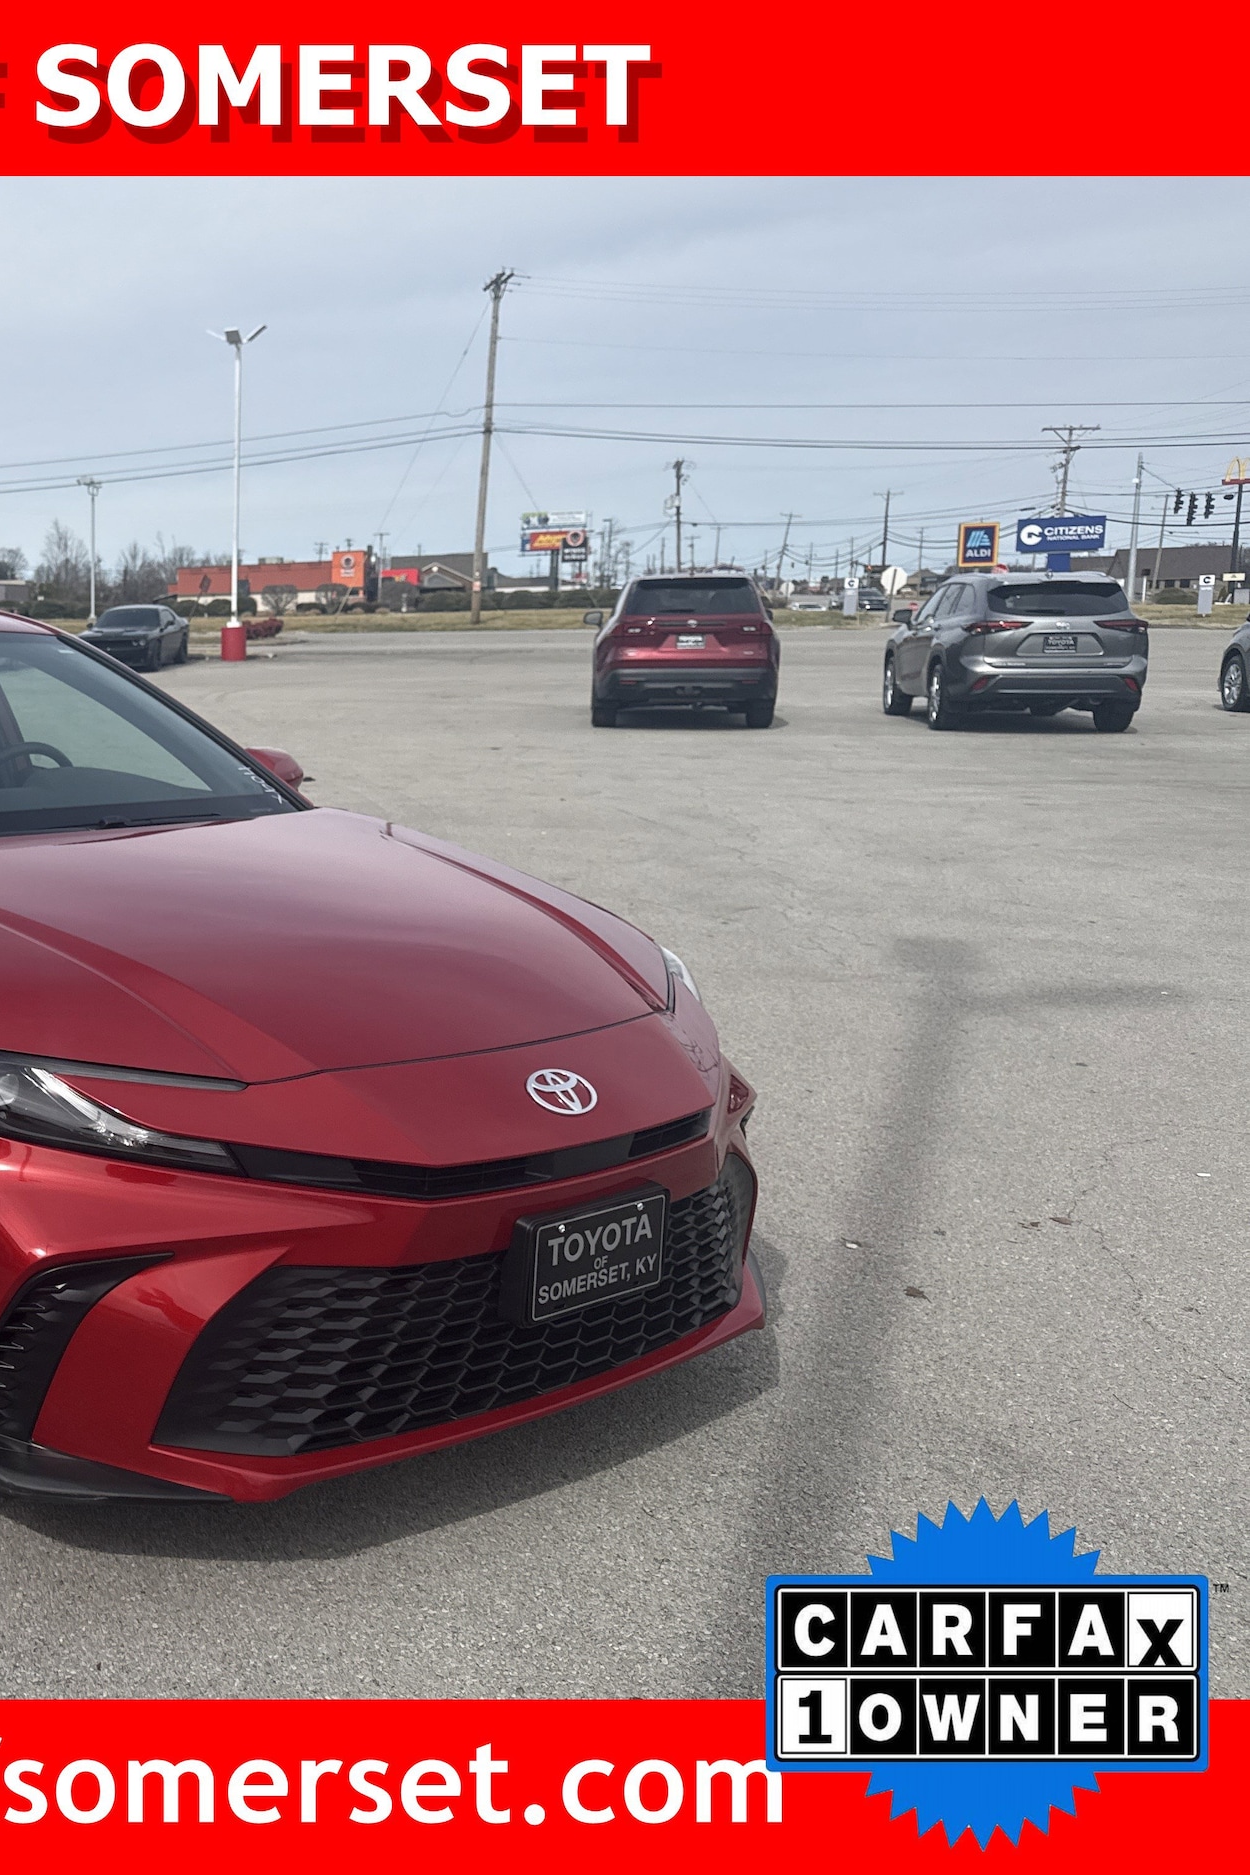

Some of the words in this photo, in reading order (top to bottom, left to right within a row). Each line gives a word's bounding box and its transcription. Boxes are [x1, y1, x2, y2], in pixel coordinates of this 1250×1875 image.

[1044, 525, 1103, 536] CITIZENS
[965, 549, 991, 558] ALDI
[548, 1213, 653, 1267] TOYOTA
[593, 1255, 608, 1271] OF
[537, 1262, 631, 1304] SOMERSET,
[635, 1253, 658, 1276] KY
